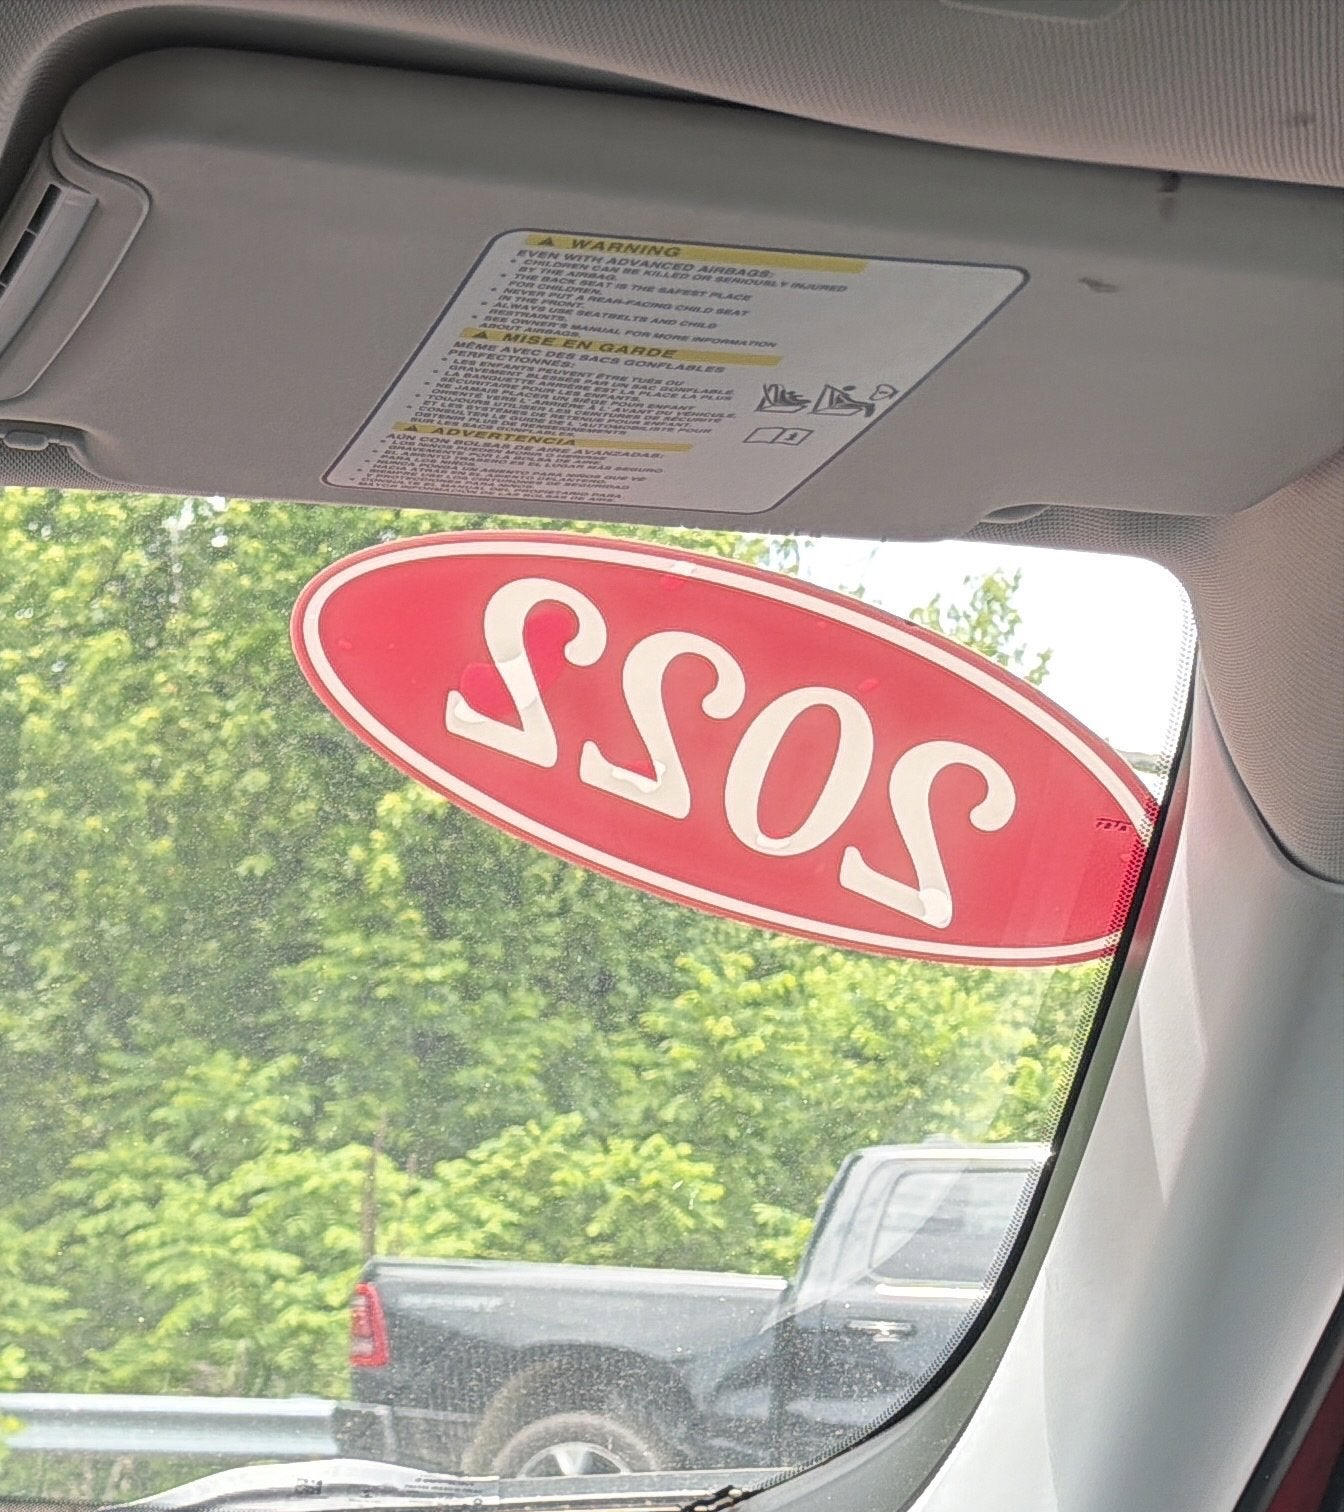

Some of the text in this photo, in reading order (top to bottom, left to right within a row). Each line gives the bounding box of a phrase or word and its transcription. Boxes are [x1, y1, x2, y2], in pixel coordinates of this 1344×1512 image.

[571, 239, 681, 257] WARNING
[517, 250, 560, 260] EVEN
[564, 253, 602, 264] WITH
[606, 257, 694, 271] ADVANCED
[523, 259, 589, 271] CHILDREN
[592, 266, 620, 275] CAN
[643, 270, 690, 280] KILLED
[502, 333, 678, 359] MISE EN GARDE
[431, 427, 575, 446] ADVERTENCIA
